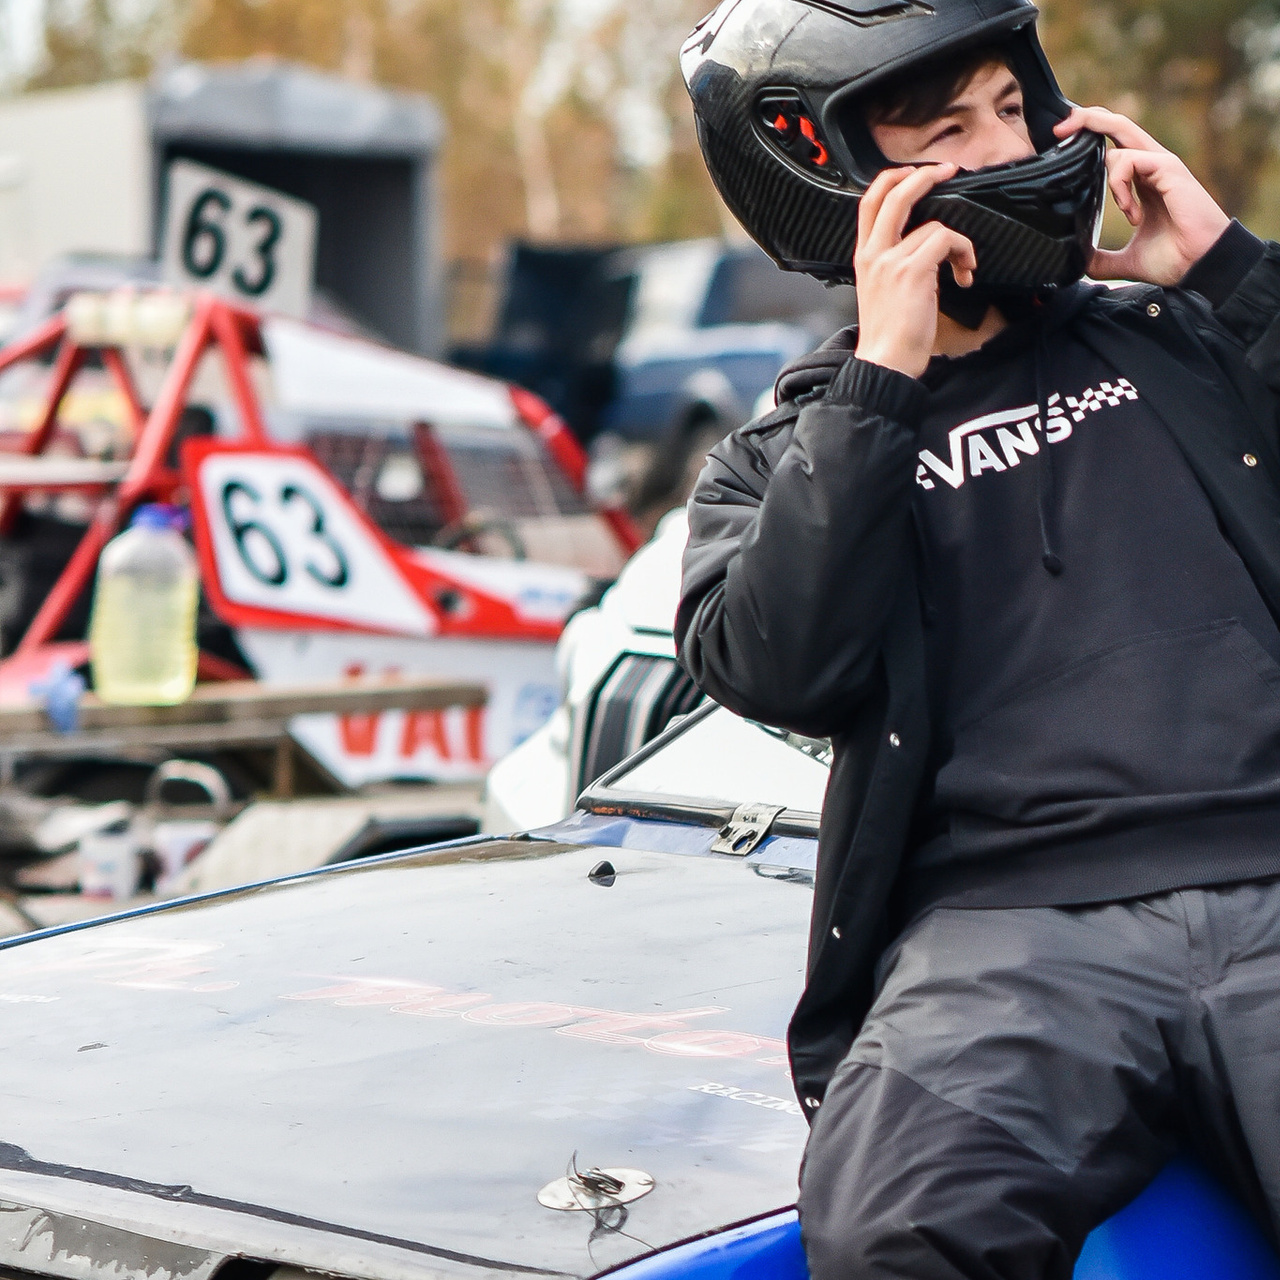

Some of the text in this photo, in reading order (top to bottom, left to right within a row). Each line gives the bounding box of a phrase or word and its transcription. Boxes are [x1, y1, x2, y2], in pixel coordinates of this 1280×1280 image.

[180, 186, 286, 298] 63
[917, 402, 1073, 490] VANS
[220, 478, 352, 590] 63
